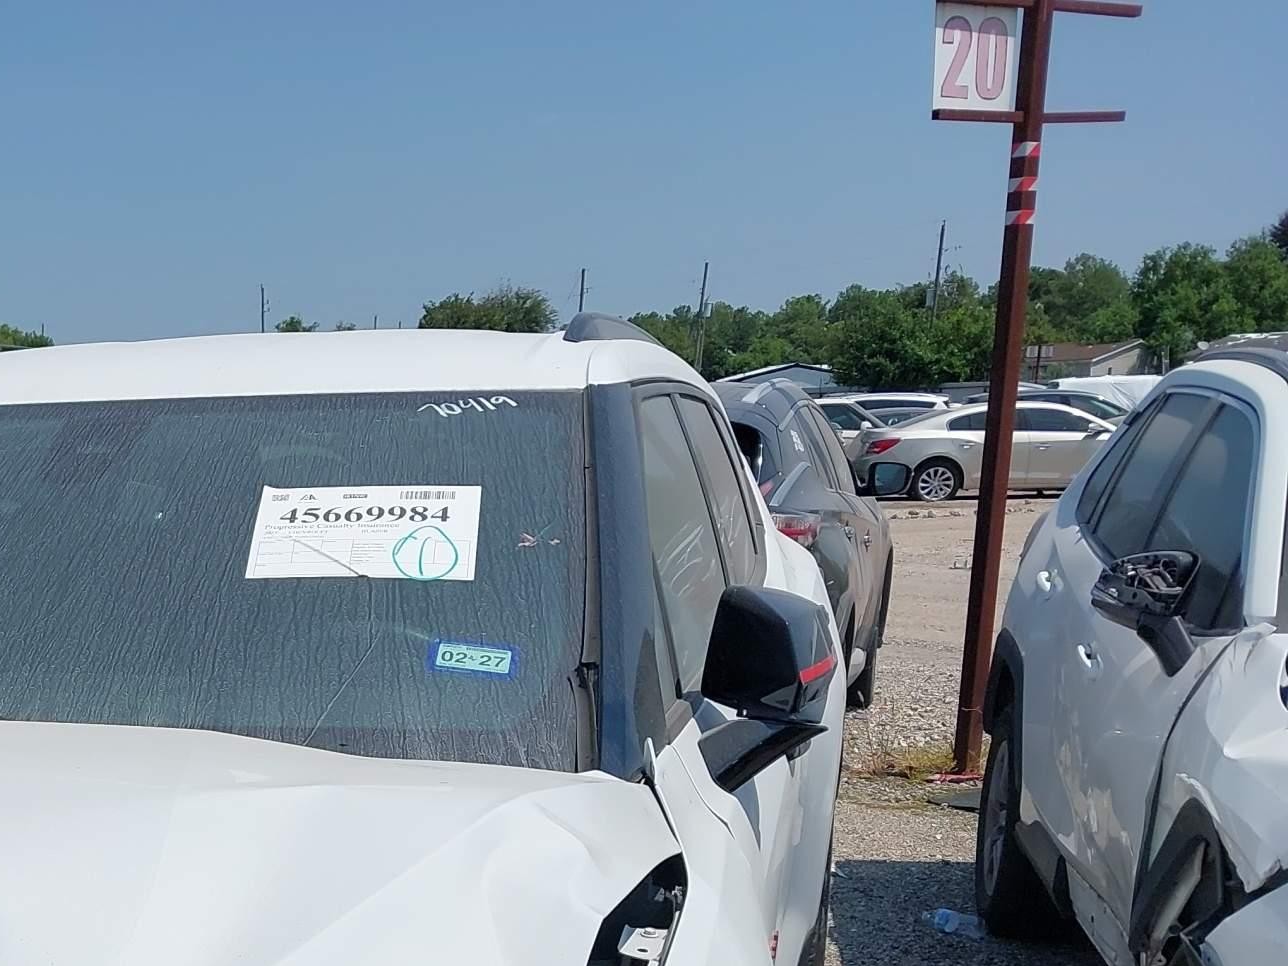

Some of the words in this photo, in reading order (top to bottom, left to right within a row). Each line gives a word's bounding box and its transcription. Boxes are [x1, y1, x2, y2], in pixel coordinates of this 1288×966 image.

[941, 15, 1009, 101] 20
[279, 505, 451, 524] 45669984
[441, 650, 468, 664] 02
[478, 654, 506, 667] 27
